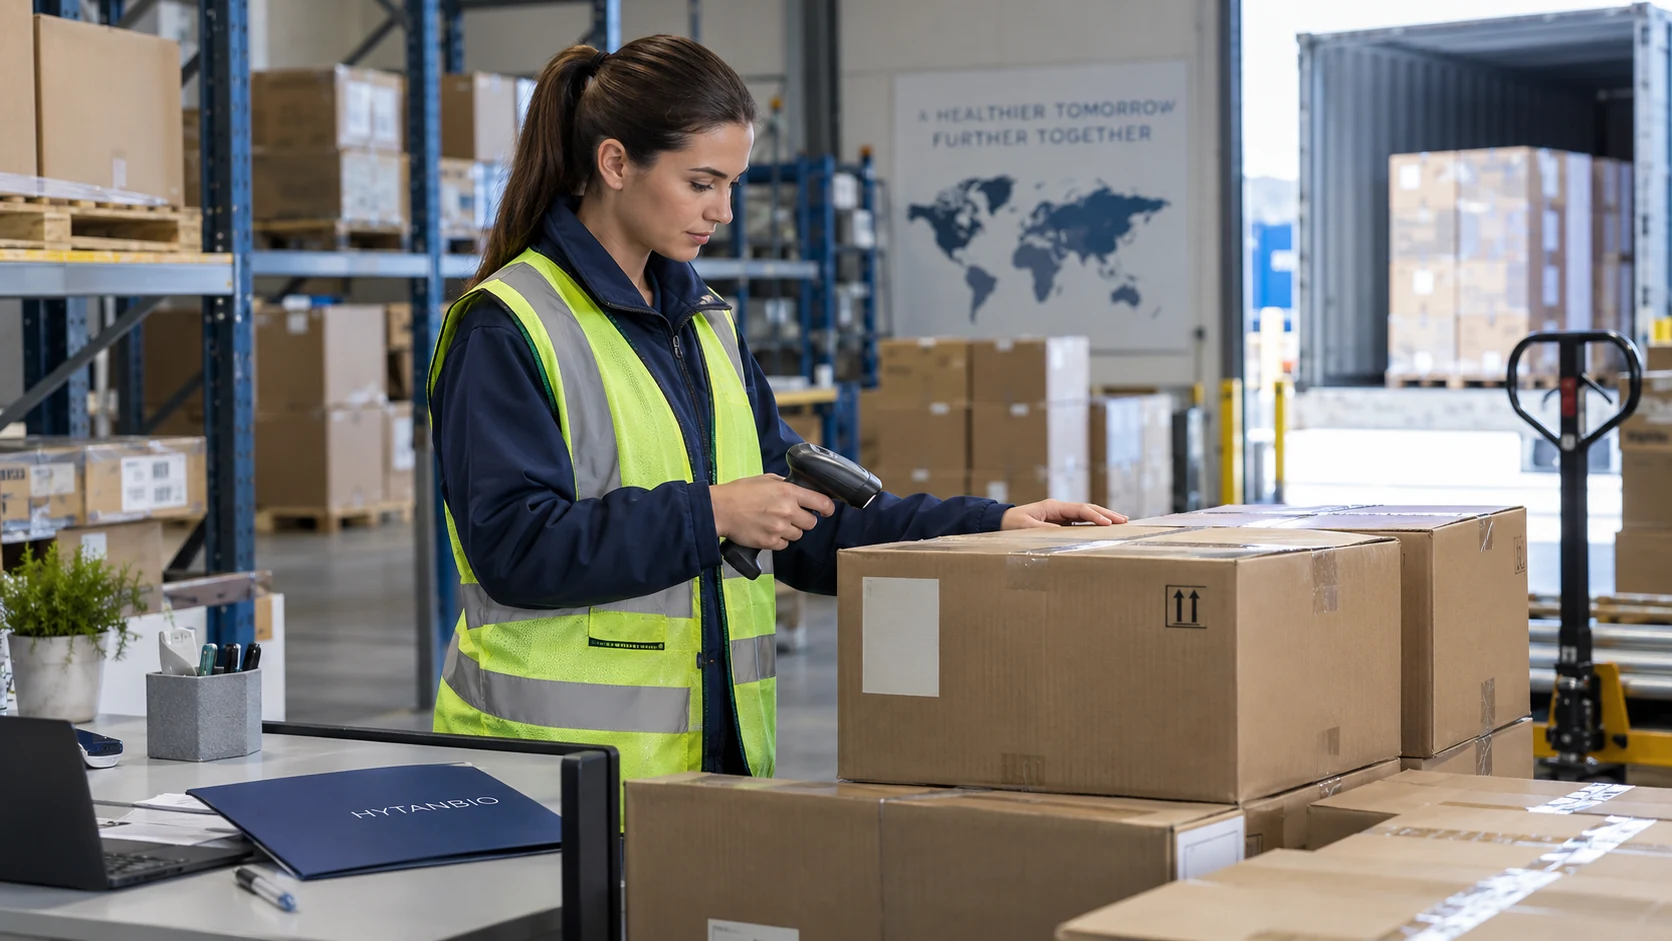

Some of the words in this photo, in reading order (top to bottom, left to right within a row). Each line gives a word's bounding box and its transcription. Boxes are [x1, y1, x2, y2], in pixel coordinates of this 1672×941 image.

[918, 110, 929, 122] A
[936, 103, 1045, 122] HEALTHIER
[1055, 99, 1176, 119] TOMORROW
[932, 130, 1028, 148] FURTHER
[1037, 125, 1152, 145] TOGETHER
[351, 796, 499, 819] HYTANBIO
